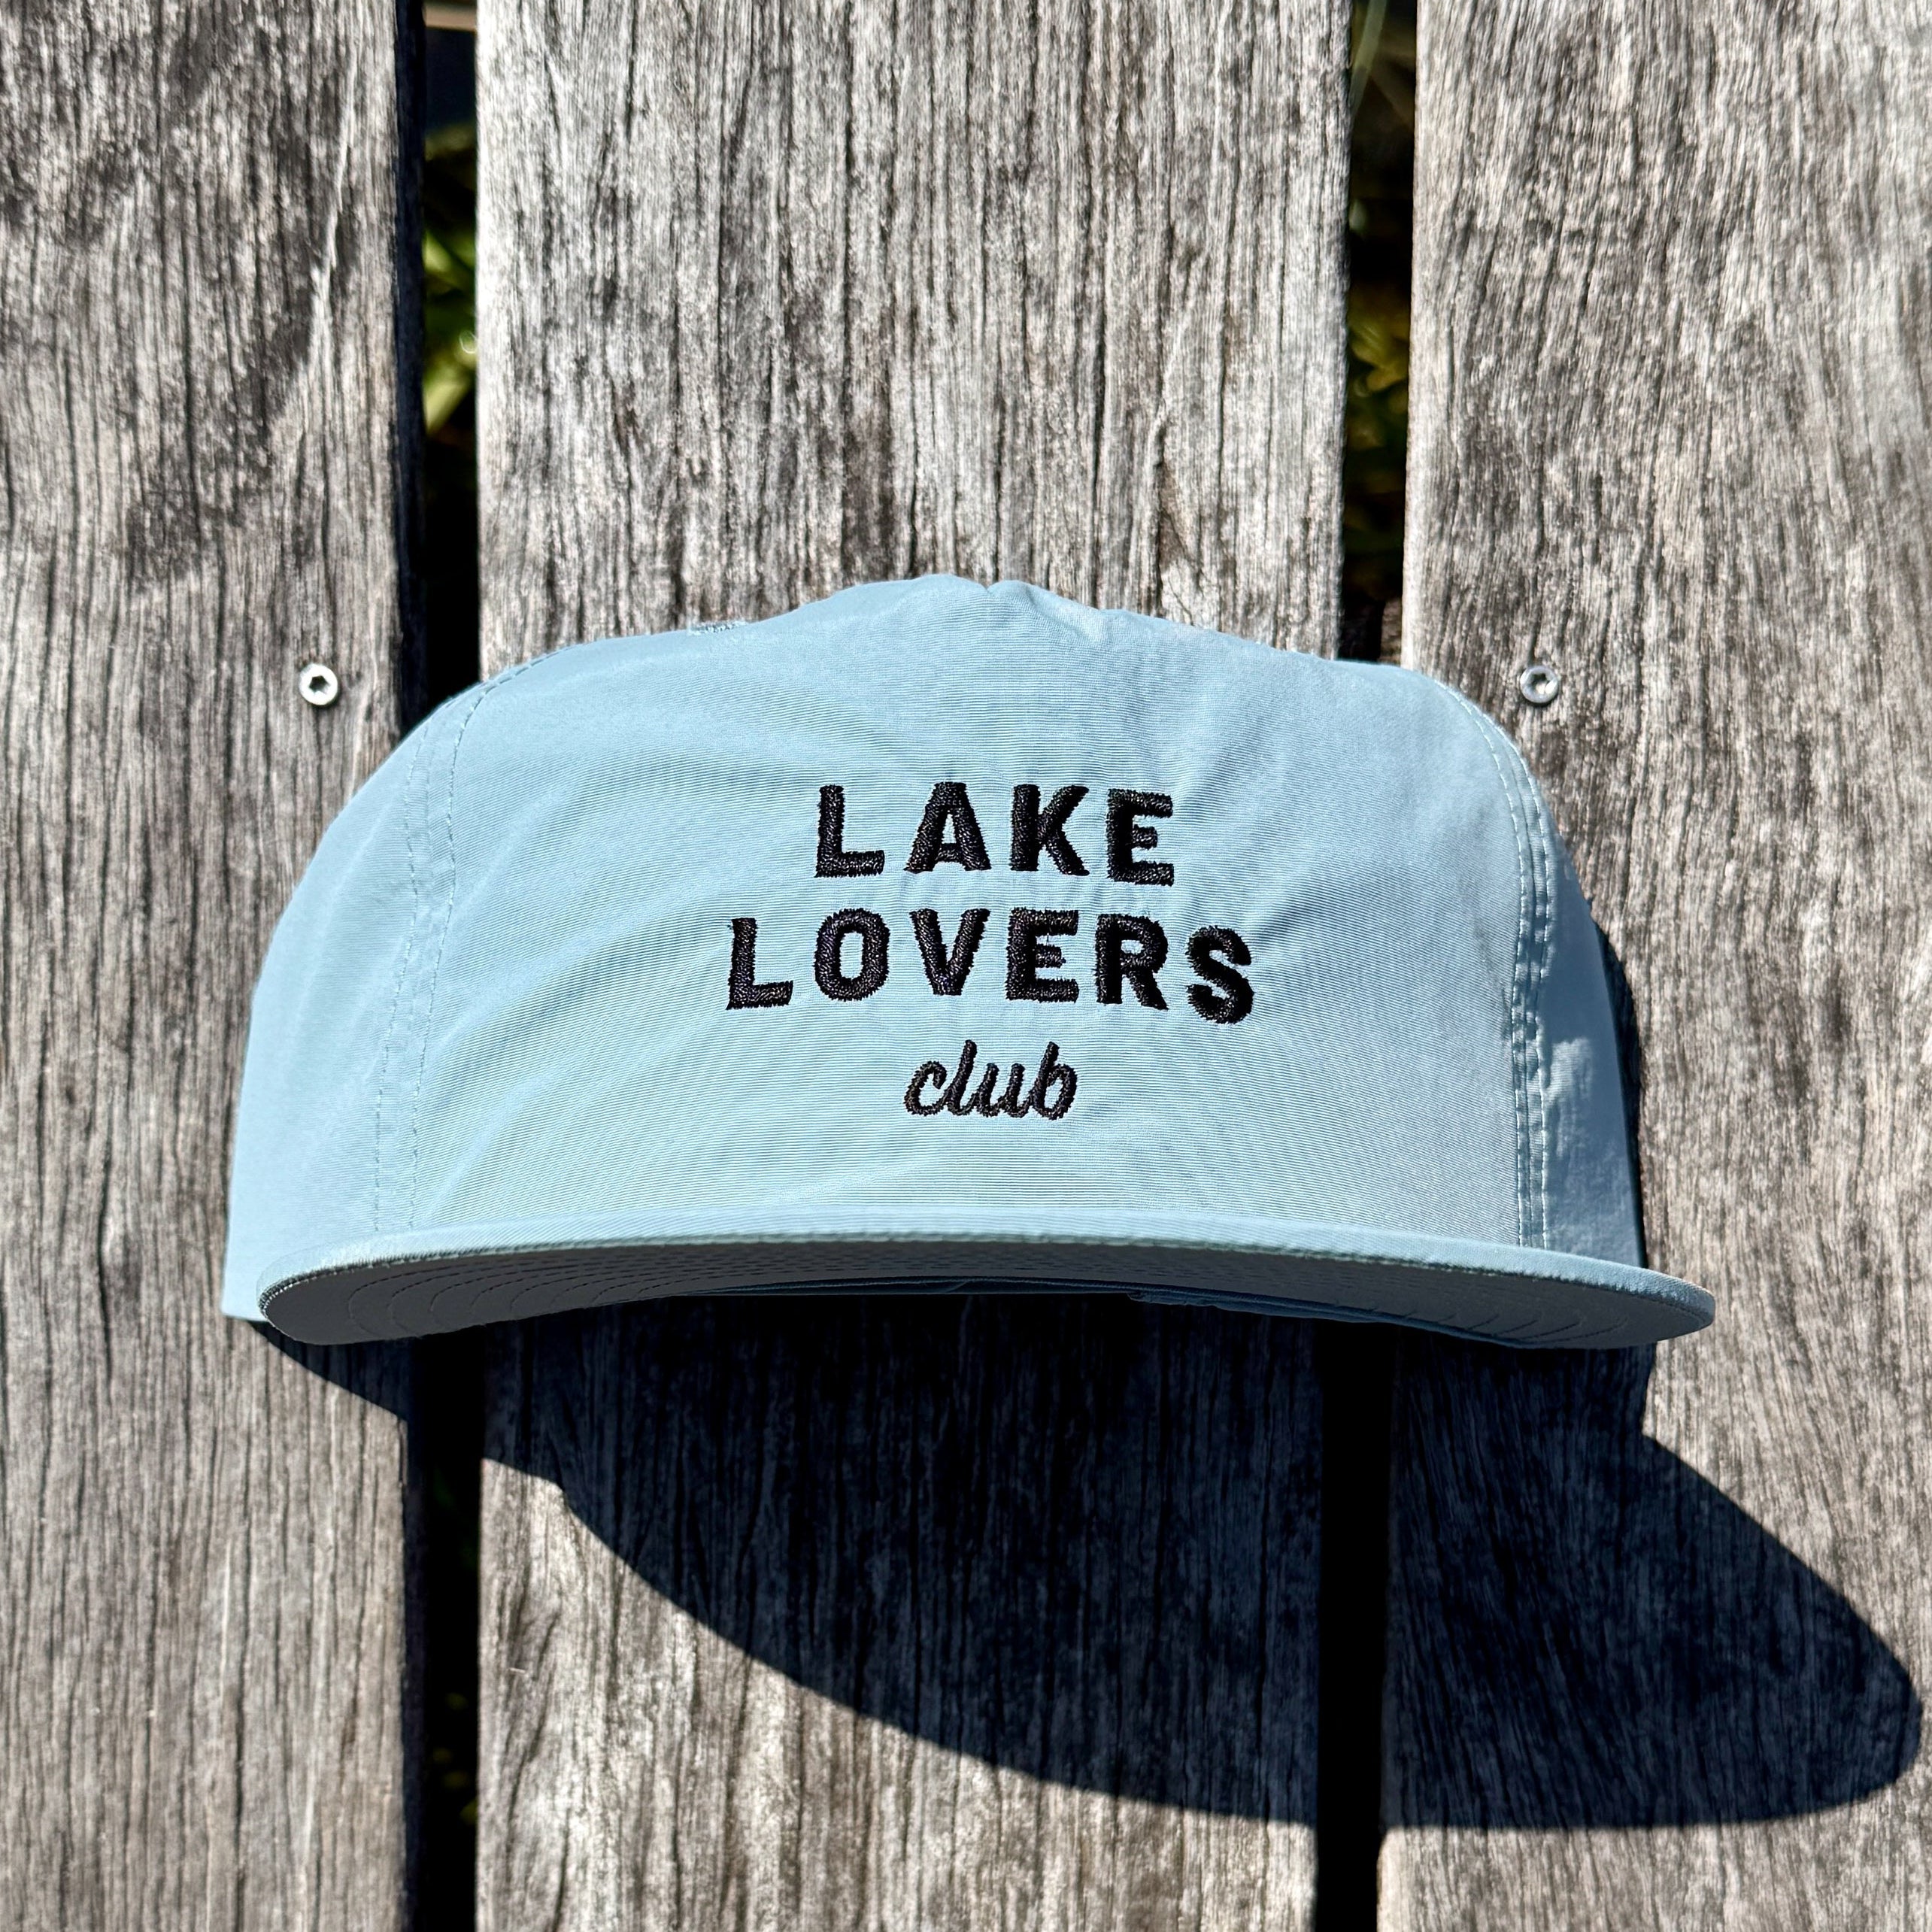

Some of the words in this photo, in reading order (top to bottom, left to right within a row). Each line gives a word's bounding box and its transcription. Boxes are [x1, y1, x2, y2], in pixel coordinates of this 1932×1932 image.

[814, 781, 1175, 887] LAKE
[726, 907, 1255, 1025] LOVERS
[903, 1039, 1078, 1121] club
